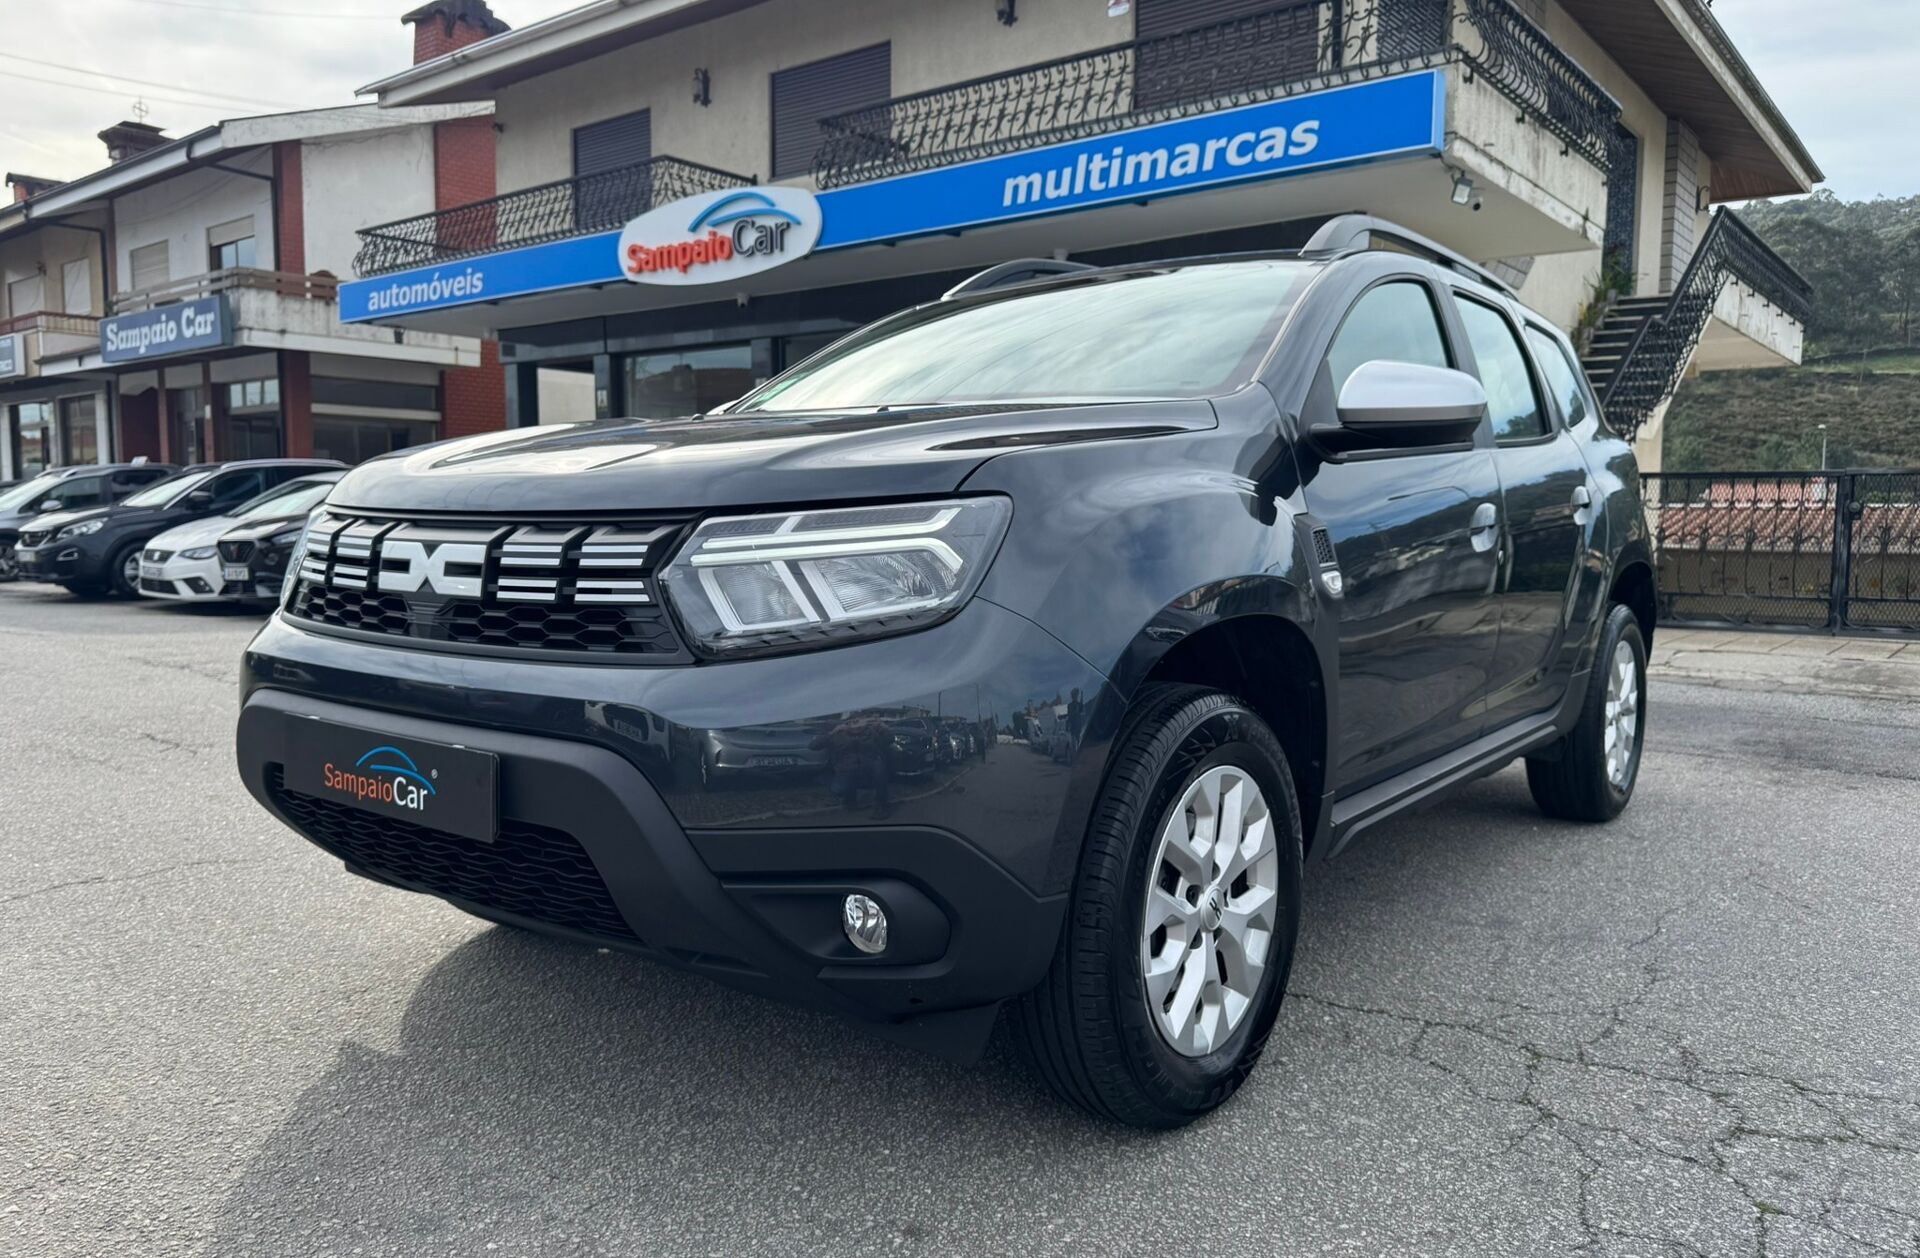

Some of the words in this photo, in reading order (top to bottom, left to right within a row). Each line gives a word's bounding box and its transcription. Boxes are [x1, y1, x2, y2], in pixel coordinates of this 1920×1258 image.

[1002, 119, 1320, 207] multimarcas
[368, 267, 483, 311] automóveis
[106, 314, 178, 354] Sampaio
[181, 306, 215, 338] Car
